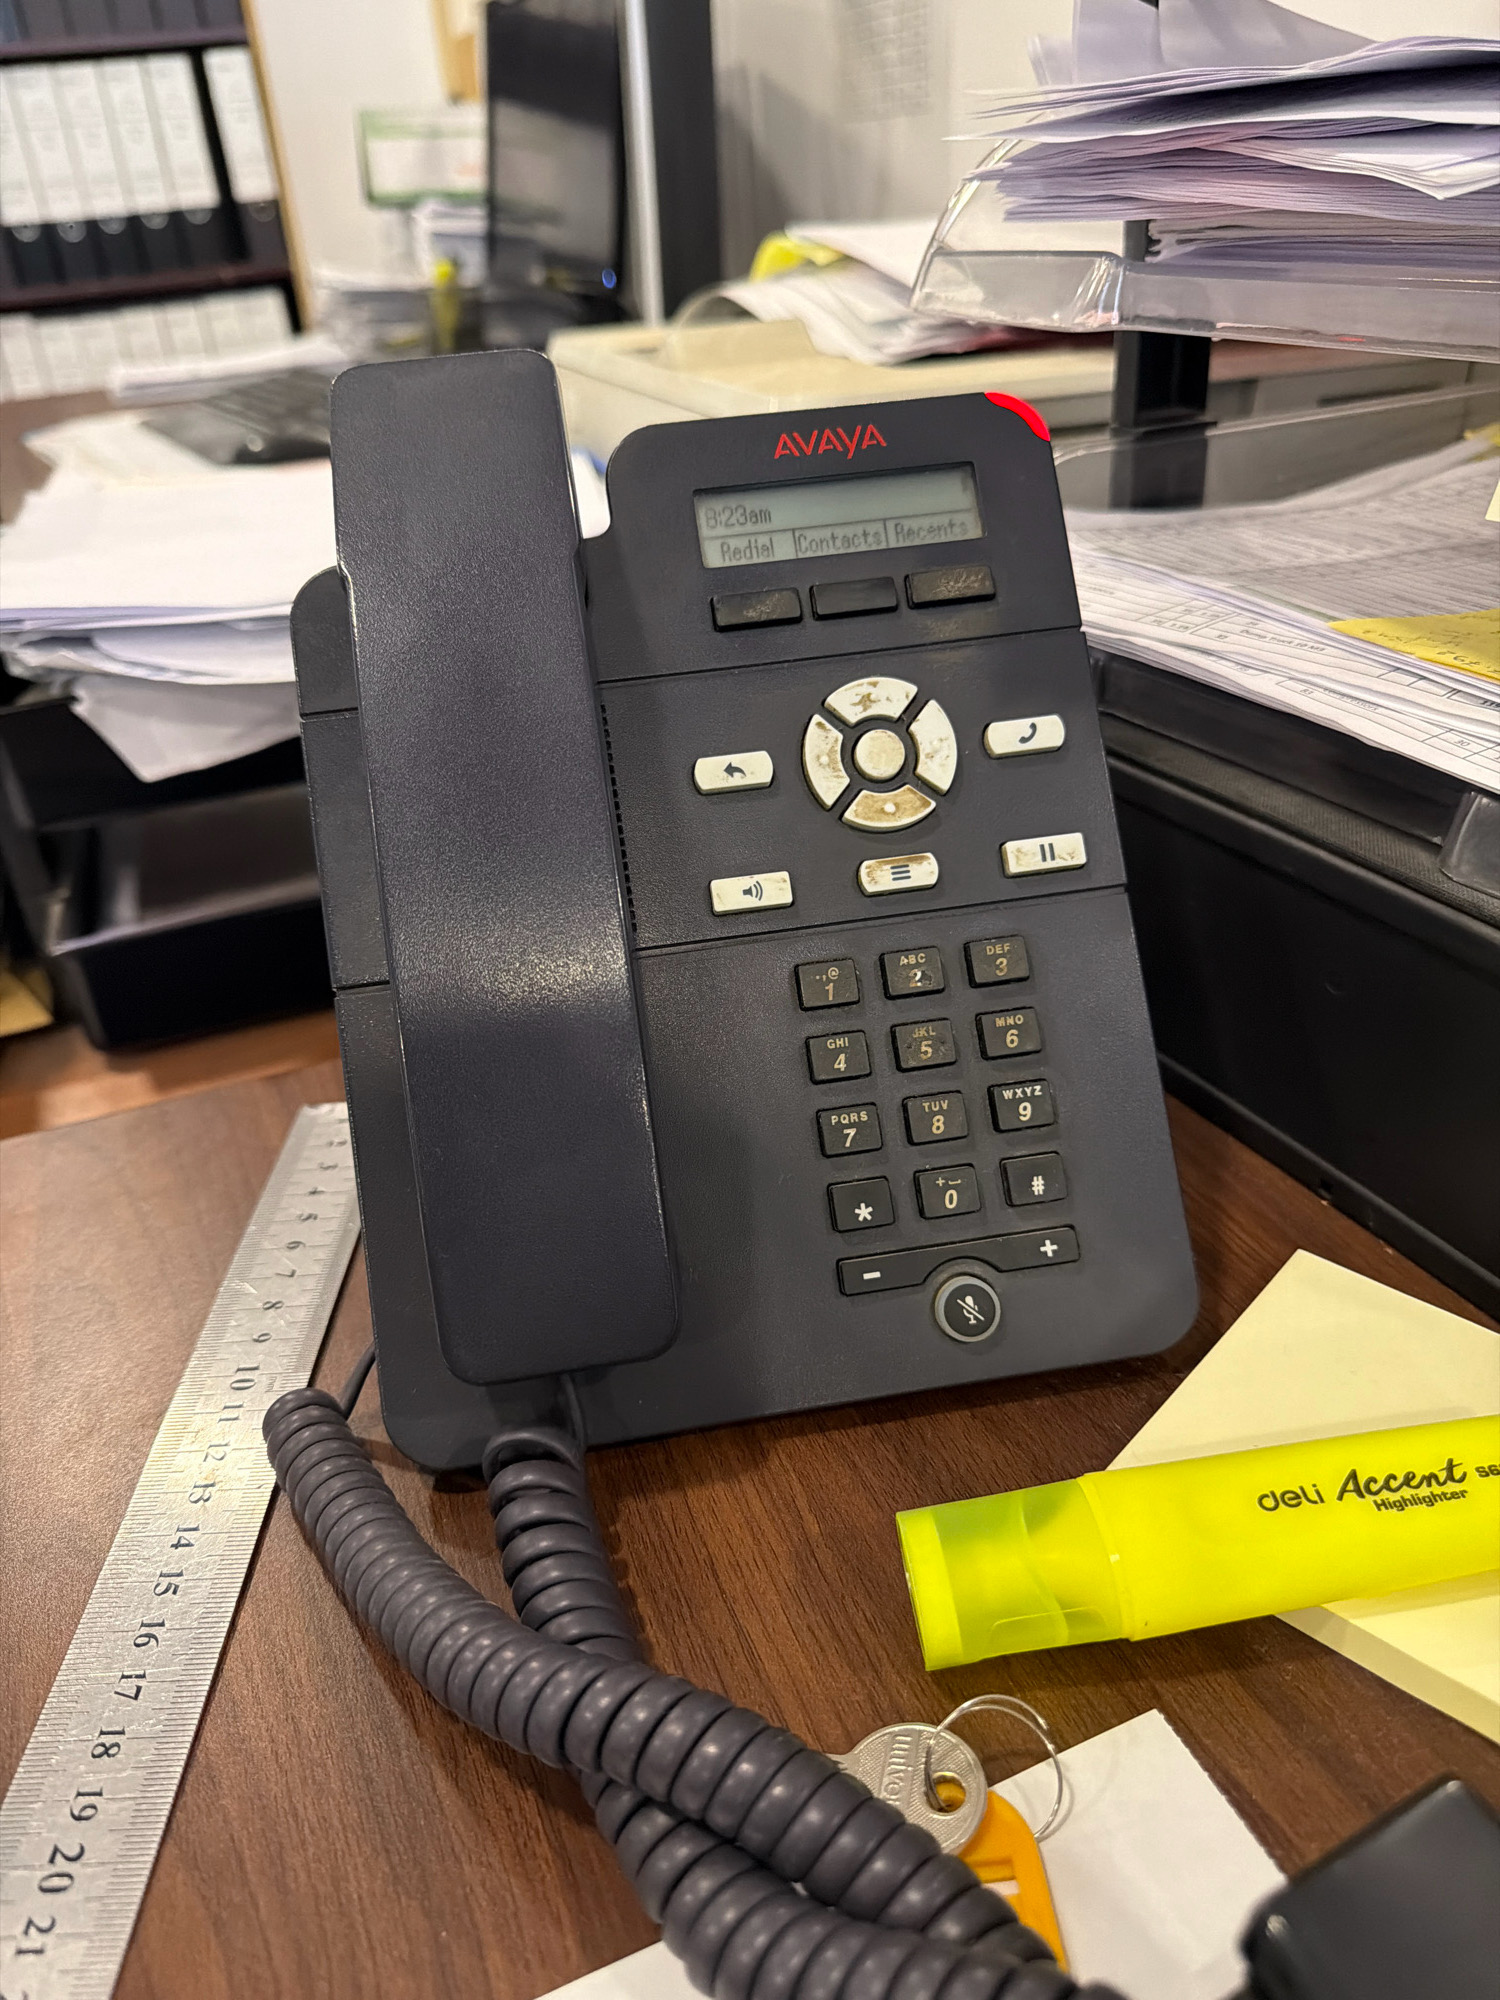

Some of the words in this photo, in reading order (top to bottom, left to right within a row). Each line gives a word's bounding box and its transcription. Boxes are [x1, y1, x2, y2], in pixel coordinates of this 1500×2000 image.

[774, 424, 887, 459] AVAYA
[704, 505, 772, 530] 8:23am
[798, 525, 882, 554] Contacts
[894, 519, 968, 542] Recents
[720, 537, 774, 563] Redial
[985, 943, 1011, 956] DEF
[899, 953, 926, 967] ABC
[995, 958, 1008, 977] 3
[909, 968, 922, 987] 2
[824, 982, 835, 1001] 1
[995, 1014, 1025, 1028] MNO
[912, 1025, 936, 1039] JKL
[1005, 1030, 1019, 1049] 6
[826, 1037, 849, 1050] GHI
[920, 1040, 933, 1060] 5
[833, 1053, 847, 1072] 4
[1002, 1085, 1043, 1100] WXYZ
[922, 1099, 949, 1113] TUV
[1018, 1102, 1032, 1122] 9
[831, 1110, 869, 1126] PQRS
[931, 1115, 945, 1135] 8
[842, 1128, 857, 1148] 7
[943, 1189, 958, 1209] 0
[286, 1240, 306, 1250] 6
[275, 1268, 298, 1279] 7
[262, 1300, 285, 1311] 8
[252, 1332, 273, 1343] 9
[230, 1363, 261, 1391] 10
[217, 1401, 245, 1423] 11
[203, 1441, 231, 1463] 12
[188, 1480, 217, 1504] 13
[1257, 1483, 1326, 1512] deli
[1335, 1457, 1468, 1502] Accent
[1474, 1462, 1500, 1479] S6
[1372, 1488, 1469, 1513] Highlighter
[170, 1524, 201, 1550] 14
[153, 1569, 185, 1597] 15
[133, 1618, 167, 1649] 16
[114, 1669, 148, 1701] 17
[91, 1726, 126, 1759] 18
[69, 1787, 104, 1822] 19
[38, 1842, 85, 1894] 20
[15, 1916, 56, 1957] 21
